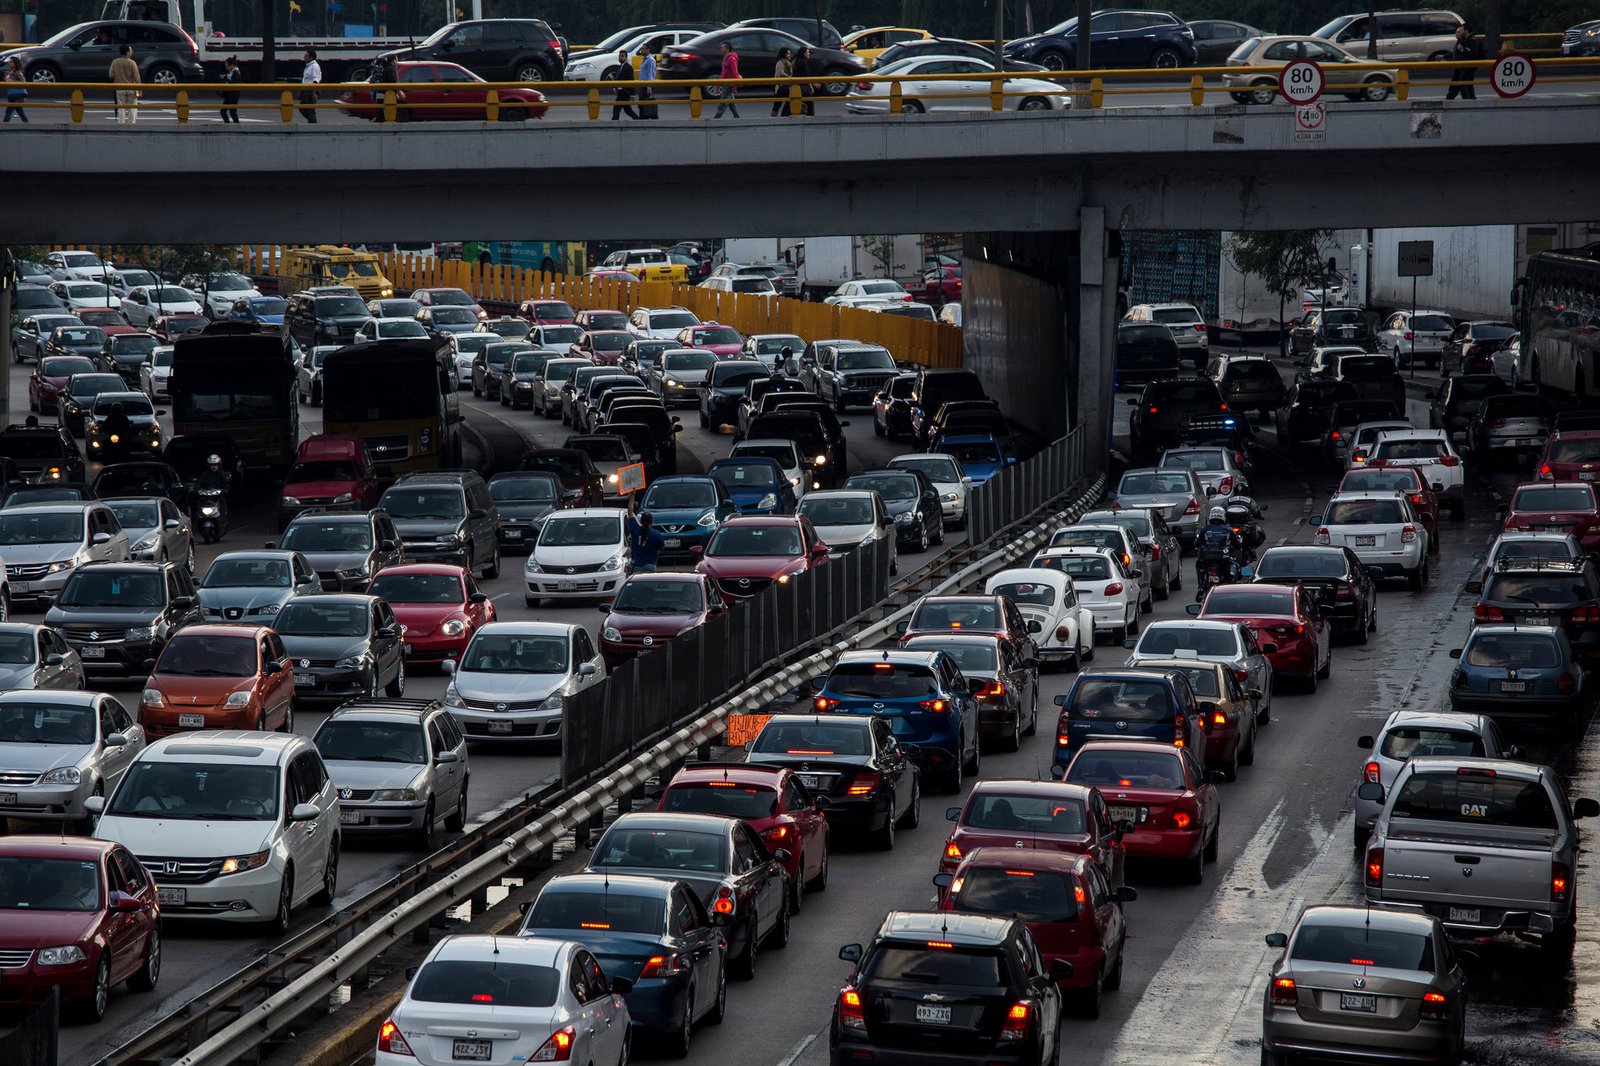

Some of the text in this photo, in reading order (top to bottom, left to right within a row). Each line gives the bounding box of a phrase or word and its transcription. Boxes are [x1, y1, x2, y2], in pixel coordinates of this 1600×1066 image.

[1502, 61, 1524, 76] 80
[1291, 68, 1313, 83] 80
[1501, 79, 1524, 87] km/h
[1290, 85, 1313, 94] km/h
[1461, 803, 1488, 817] CAT
[917, 1008, 950, 1020] 493-ZXG
[456, 1044, 489, 1055] 422-ZSY
